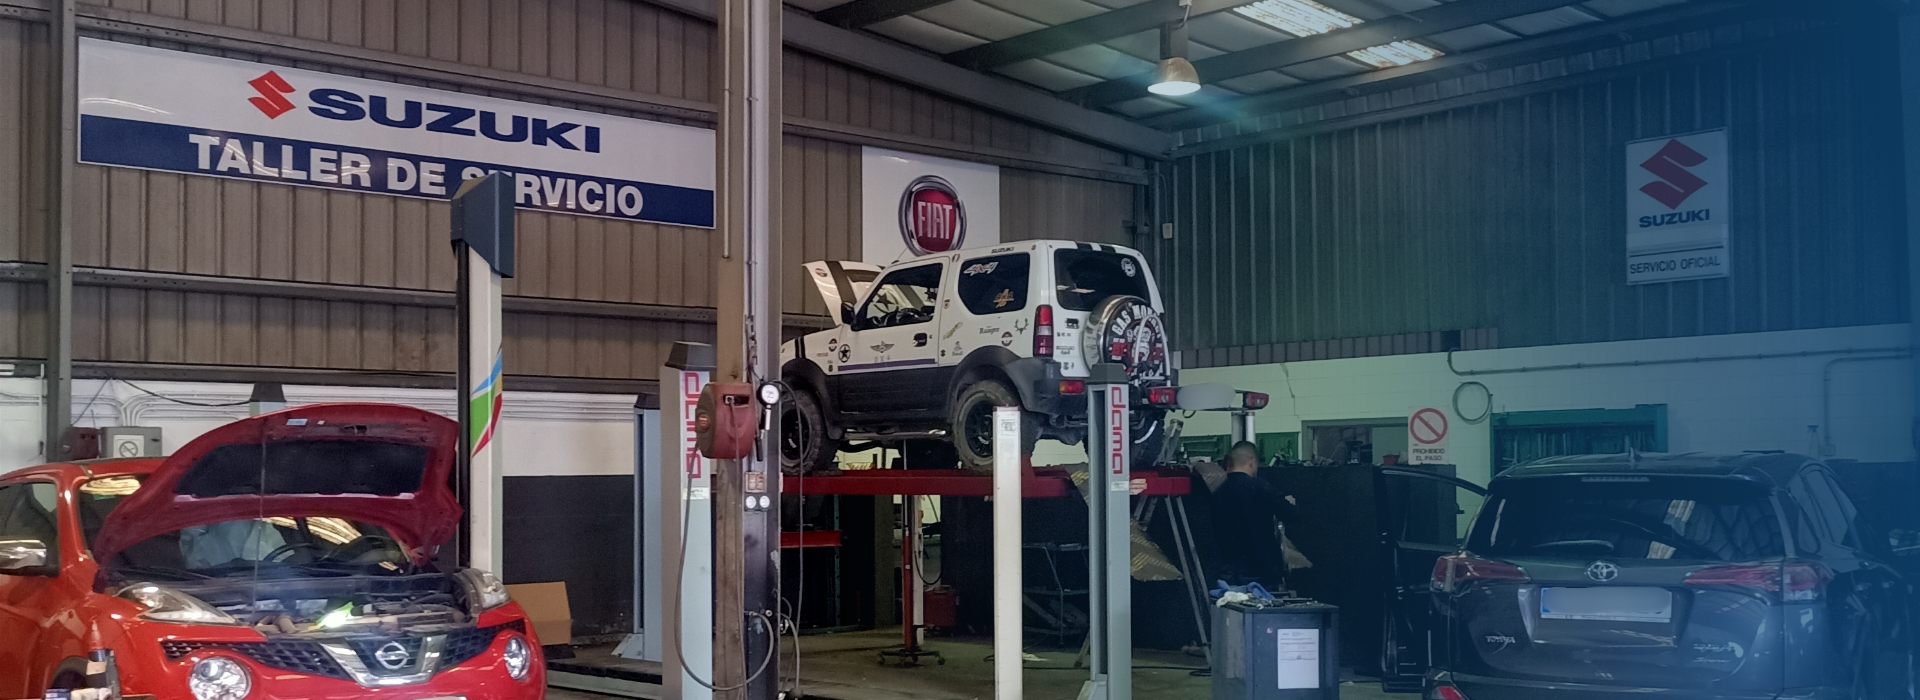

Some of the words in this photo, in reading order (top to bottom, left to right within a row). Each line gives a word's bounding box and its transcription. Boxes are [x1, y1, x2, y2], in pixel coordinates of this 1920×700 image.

[308, 88, 600, 153] SUZUKI
[188, 133, 371, 187] TALLER
[387, 157, 446, 195] DE
[462, 166, 644, 216] RVICIO
[917, 201, 953, 240] FIAT
[1639, 208, 1710, 228] SUZUKI
[1629, 260, 1676, 274] SERVICIO
[1680, 256, 1721, 270] OFICIAL
[1111, 310, 1132, 336] GAS
[1111, 386, 1126, 475] dama
